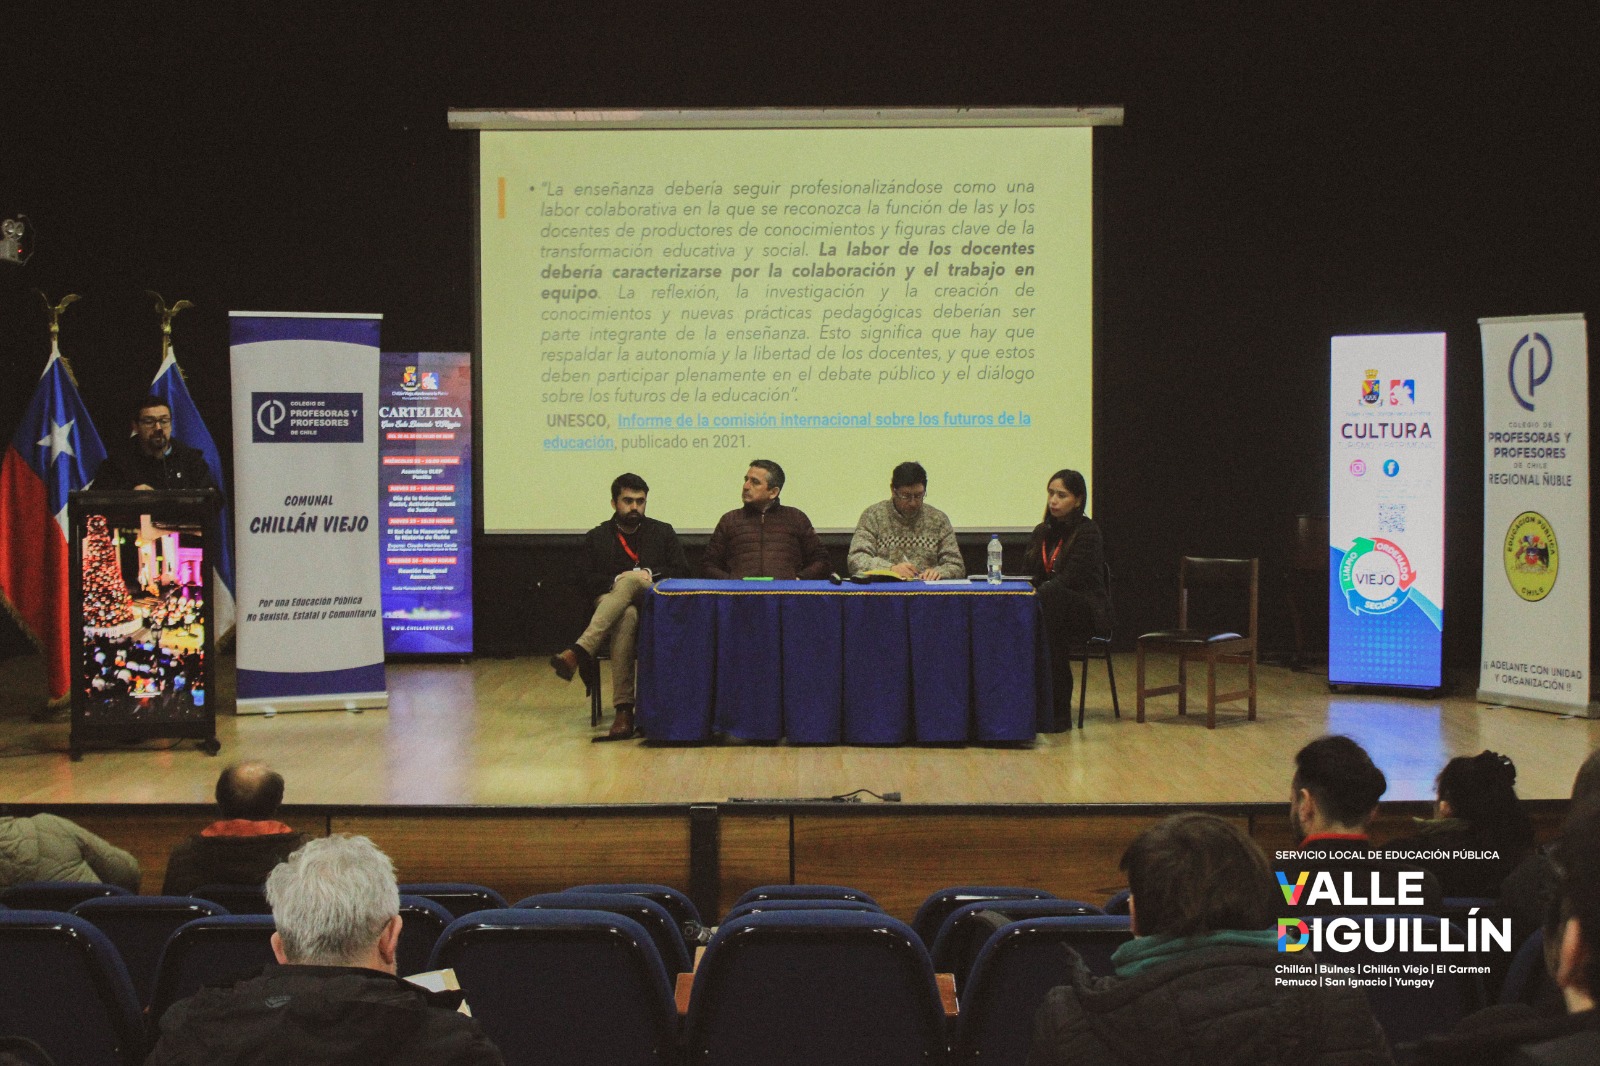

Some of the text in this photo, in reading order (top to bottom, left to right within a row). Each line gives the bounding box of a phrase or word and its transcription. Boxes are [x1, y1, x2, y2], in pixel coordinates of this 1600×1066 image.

[574, 182, 654, 196] enseñanza
[665, 181, 722, 195] debería
[733, 182, 780, 198] seguir
[790, 179, 942, 198] profesionalizándose
[953, 182, 996, 193] como
[1007, 182, 1034, 193] una
[541, 198, 1035, 220] labor colaborativa en la que se reconozca la función de las y los
[541, 220, 1034, 240] docentes de productores de conocimientos y figuras clave de la
[541, 241, 1035, 261] transformación educativa y social. La labor de los docentes
[541, 262, 1034, 282] debería caracterizarse por la colaboración y el trabajo en
[541, 282, 1035, 303] equipo. La reflexión, la investigación y la creación de
[541, 303, 1035, 323] conocimientos y nuevas prácticas pedagógicas deberían ser
[379, 407, 463, 418] CARTELERA
[547, 411, 1031, 429] UNESCO, Informe de la comisión internacional sobre los futuros de la
[1341, 423, 1431, 439] CULTURA
[1489, 432, 1572, 443] PROFESORAS Y
[544, 435, 750, 451] educación, publicado en 2021.
[1494, 448, 1566, 459] PROFESORES
[1489, 472, 1572, 486] REGIONAL ÑUBLE
[284, 495, 333, 506] COMUNAL
[250, 512, 369, 534] CHILLÁN VIEJO
[1343, 552, 1358, 581] LIMPIO
[1376, 543, 1409, 581] ORDENADO
[1356, 574, 1395, 585] VIEJO
[1522, 587, 1544, 596] CHILE
[259, 597, 362, 607] Por una Educación Pública
[1365, 597, 1398, 609] SEGURO
[247, 613, 256, 621] No
[293, 611, 319, 620] Estatal
[322, 612, 326, 620] y
[329, 609, 376, 618] Comunitaria
[1490, 661, 1528, 673] ADELANTE
[1530, 665, 1548, 675] CON
[1552, 669, 1582, 680] UNIDAD
[1494, 674, 1499, 683] Y
[1502, 674, 1564, 691] ORGANIZACIÓN
